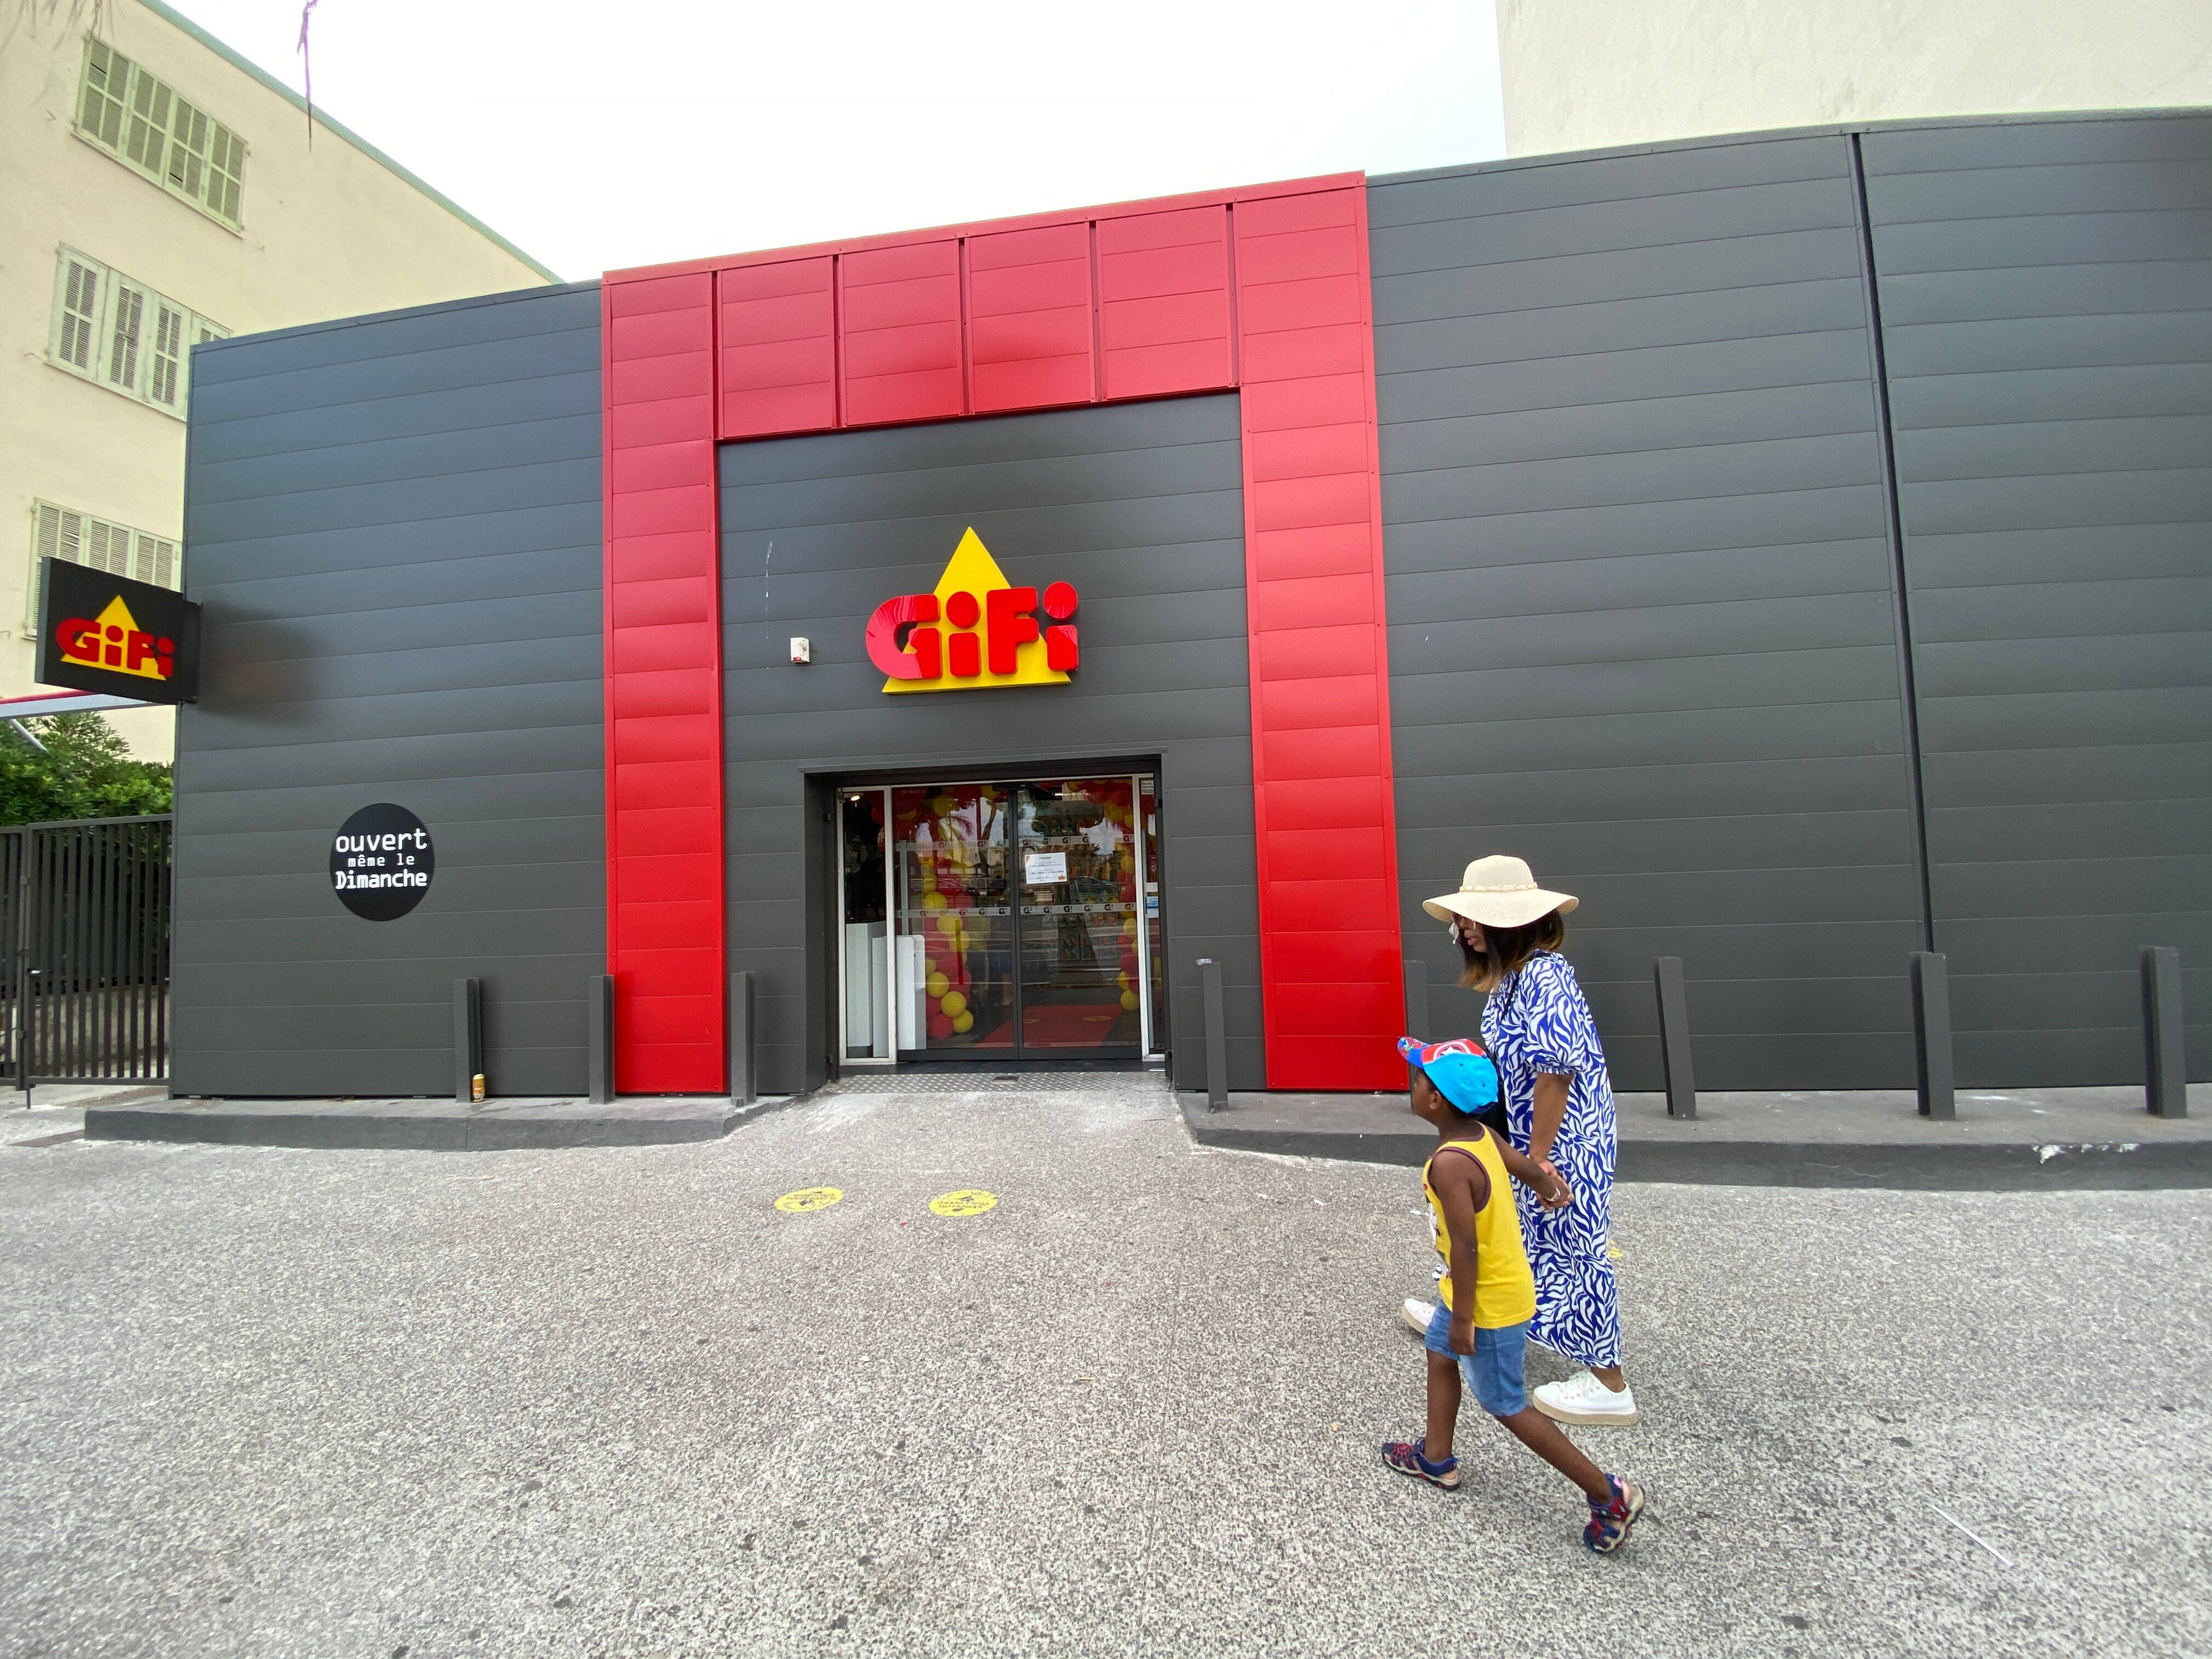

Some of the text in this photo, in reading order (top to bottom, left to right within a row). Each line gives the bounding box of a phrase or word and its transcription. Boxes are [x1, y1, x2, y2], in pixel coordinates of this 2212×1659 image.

[865, 581, 1079, 680] GiFi
[56, 618, 174, 676] GiFi
[336, 828, 427, 852] ouvert
[348, 853, 415, 867] même le
[335, 868, 427, 889] Dimanche
